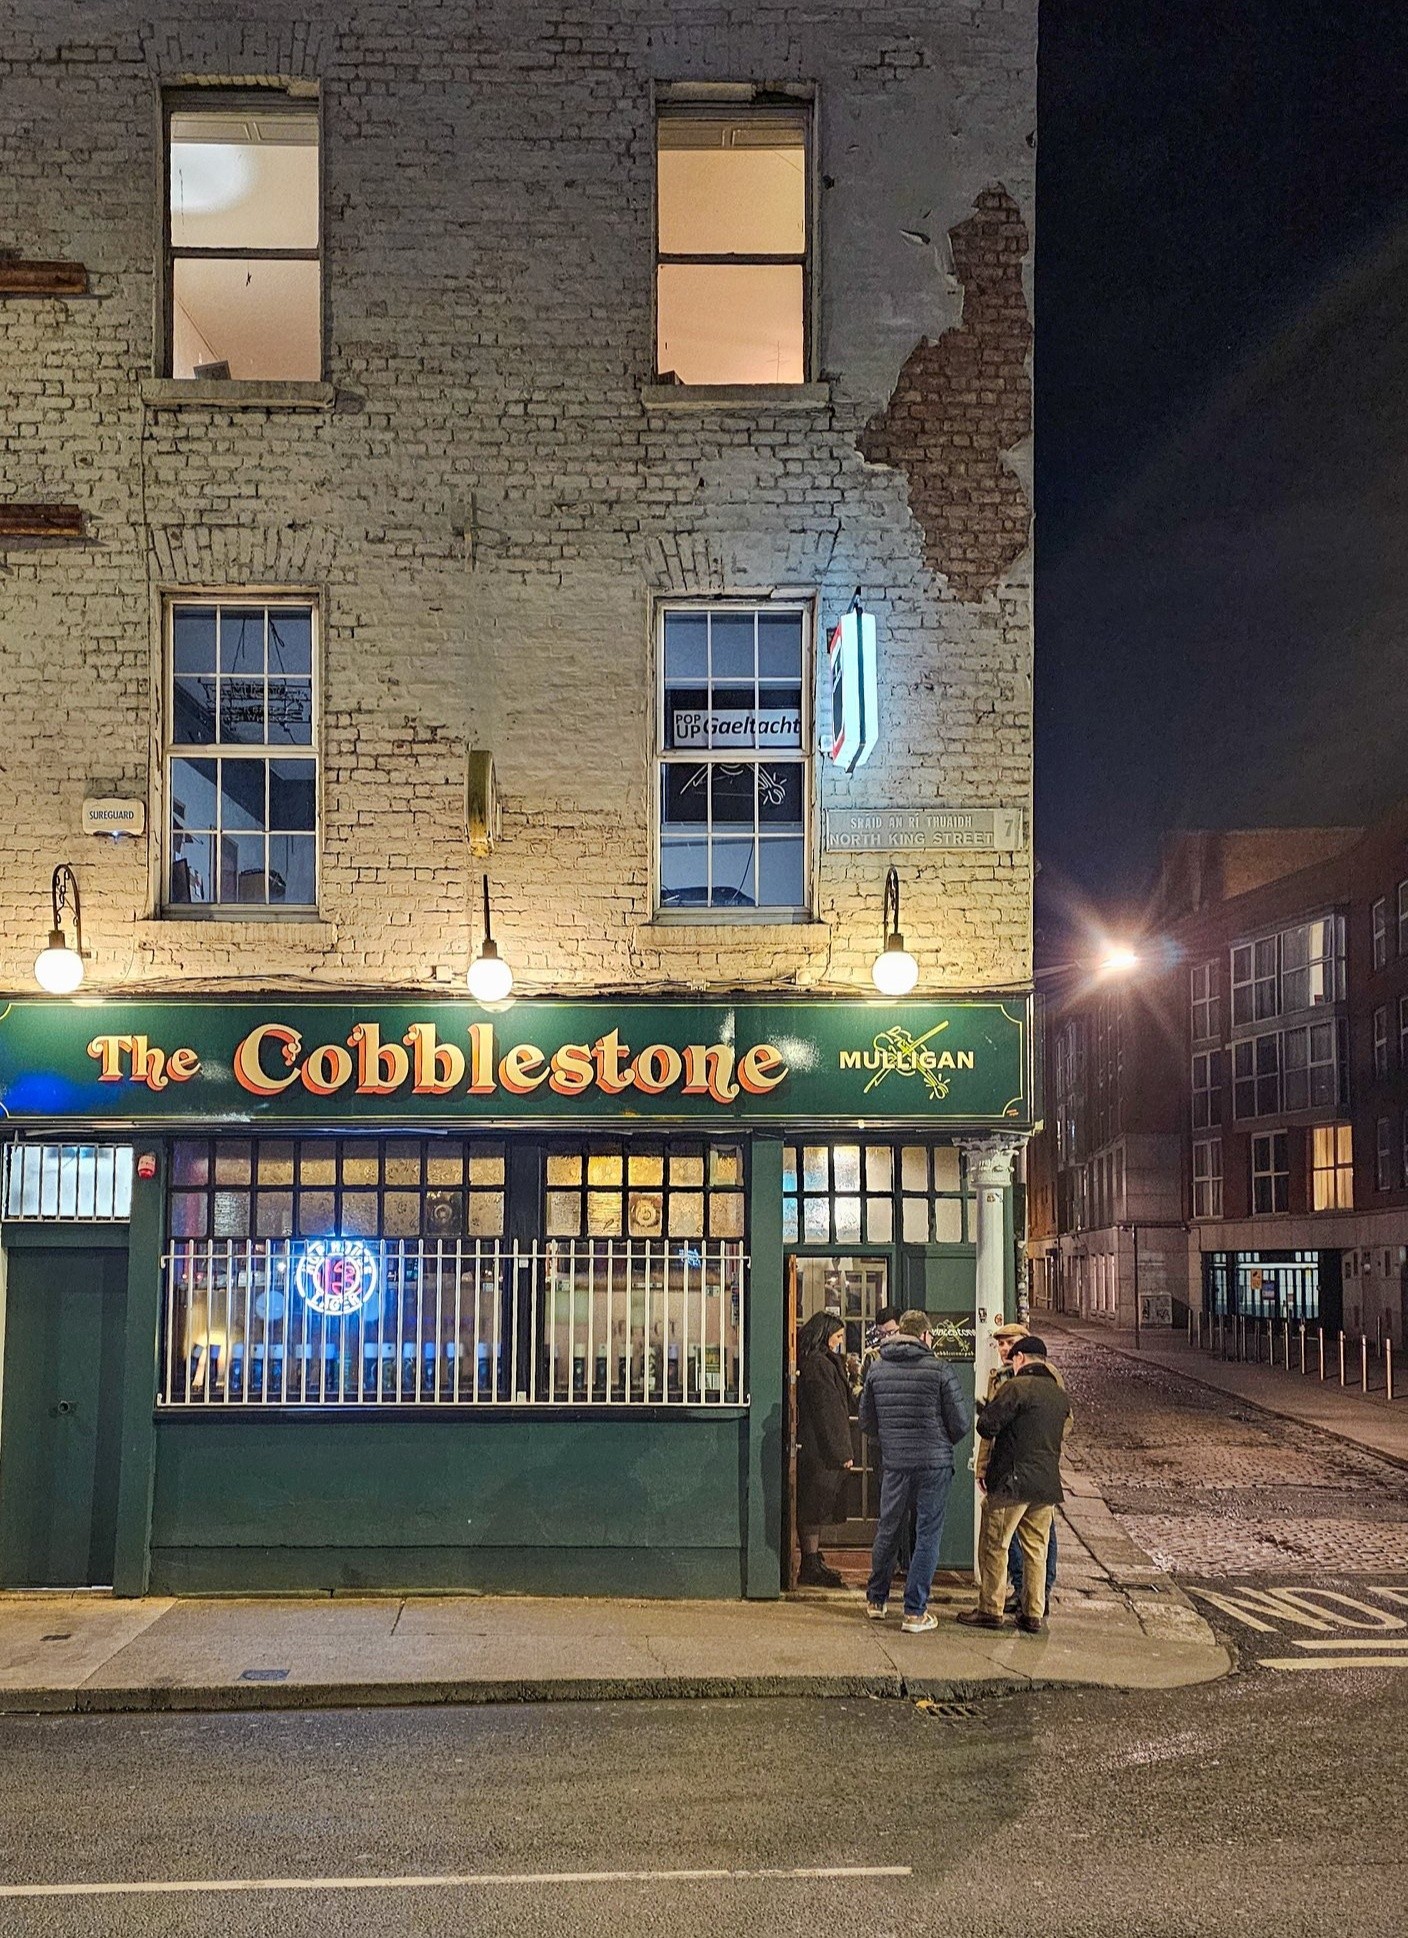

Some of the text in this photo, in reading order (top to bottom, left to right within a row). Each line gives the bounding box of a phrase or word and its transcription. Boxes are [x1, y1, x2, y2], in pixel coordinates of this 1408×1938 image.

[675, 714, 701, 725] POP
[703, 716, 800, 735] Gaeltacht
[676, 725, 701, 739] UP
[89, 810, 134, 820] SUREGUARD
[850, 812, 973, 829] SRÁID AN RÍ THUAIDH
[1004, 818, 1014, 837] 7
[830, 832, 994, 846] NORTH KING STREET
[87, 1022, 789, 1103] The Cobblestone
[839, 1050, 975, 1070] MULLIGAN
